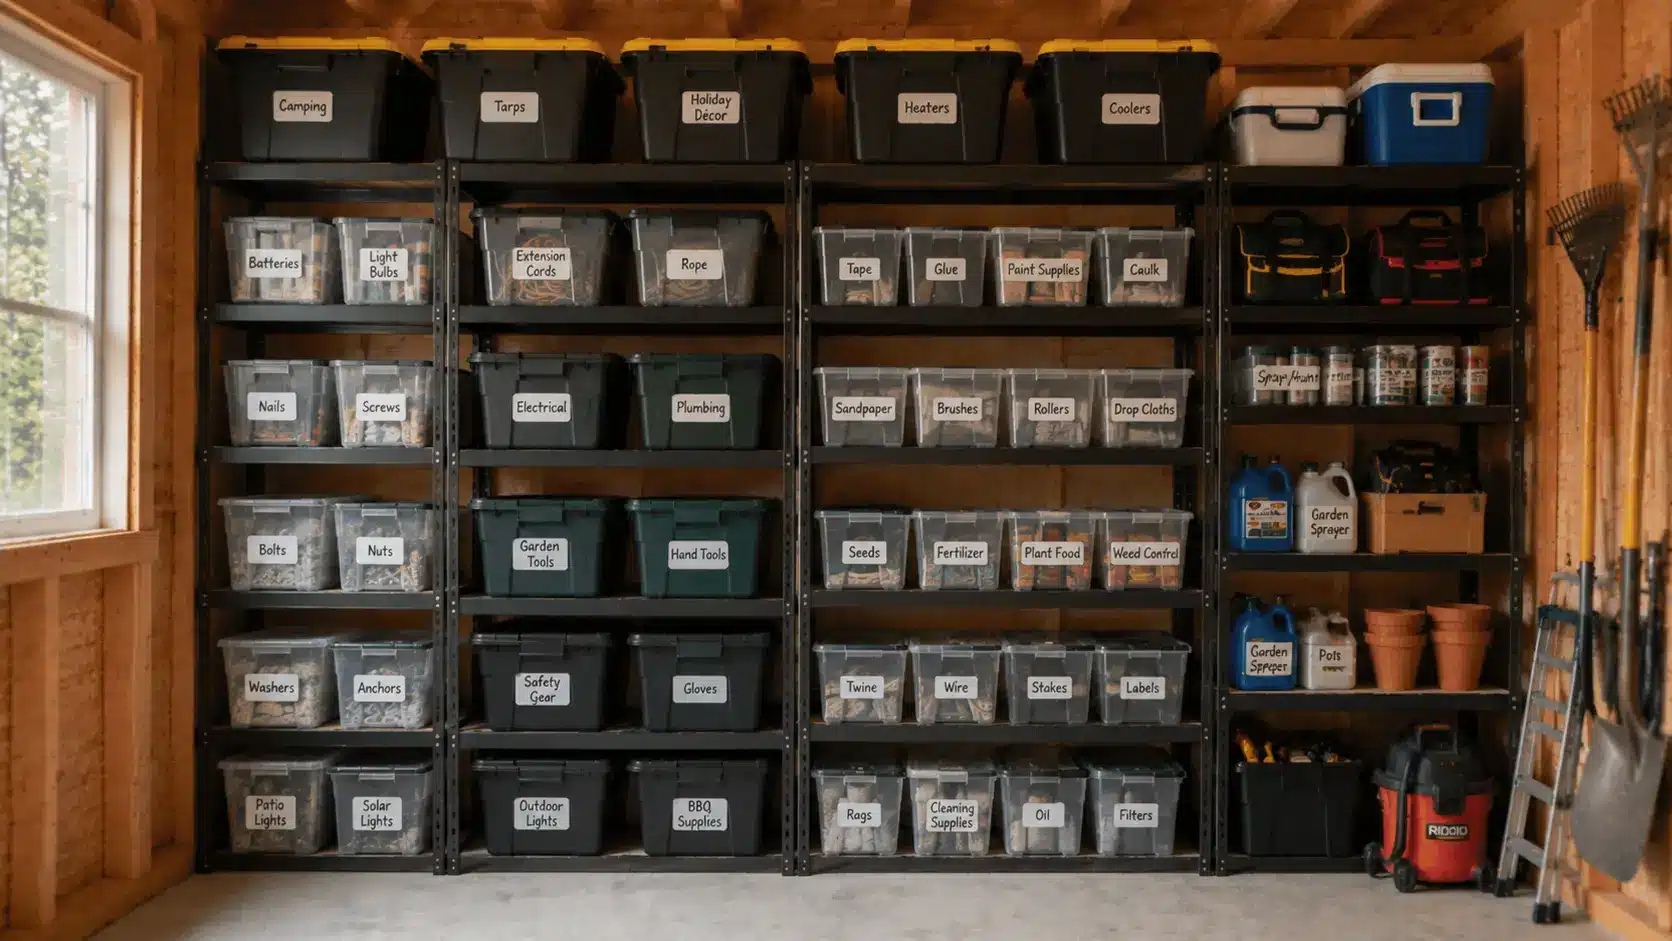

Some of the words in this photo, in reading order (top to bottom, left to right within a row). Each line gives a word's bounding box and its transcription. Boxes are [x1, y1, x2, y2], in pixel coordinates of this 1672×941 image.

[279, 99, 326, 116] Camping
[495, 100, 525, 115] Tarps
[691, 94, 731, 108] Holiday
[695, 108, 727, 120] Décor
[905, 102, 950, 114] Heaters
[1110, 102, 1150, 114] Coolers
[370, 251, 398, 265] Light
[517, 250, 565, 261] Extension
[249, 257, 299, 269] Batteries
[682, 258, 707, 273] Rope
[935, 262, 958, 275] Glue
[1130, 263, 1160, 276] Caulk
[370, 266, 398, 278] Bulbs
[527, 265, 557, 278] Cords
[847, 263, 871, 277] Tape
[1008, 263, 1035, 275] Paint
[1038, 263, 1080, 279] Supplies
[258, 400, 286, 412] Nails
[362, 401, 400, 413] Screws
[517, 401, 567, 413] Electrical
[677, 401, 725, 418] Plumbing
[835, 402, 893, 418] Sandpaper
[937, 402, 978, 414] Brushes
[1034, 402, 1070, 415] Rollers
[1114, 403, 1139, 418] Drop
[1142, 403, 1175, 415] Cloths
[1311, 508, 1349, 520] Garden
[1311, 523, 1350, 539] Sprayer
[259, 543, 286, 556] Bolts
[368, 545, 393, 557] Nuts
[520, 541, 559, 551] Garden
[849, 546, 880, 558] Seeds
[937, 546, 984, 559] Fertilizer
[672, 548, 697, 559] Hand
[700, 548, 725, 560] Tools
[1025, 547, 1052, 559] Plant
[1055, 547, 1081, 559] Food
[1113, 547, 1141, 559] Weed
[528, 556, 554, 567] Tools
[1251, 645, 1288, 658] Garden
[249, 681, 294, 694] Washers
[358, 681, 402, 694] Anchors
[525, 676, 560, 690] Safety
[684, 682, 717, 694] Gloves
[846, 680, 877, 693] Twine
[945, 681, 968, 693] Wire
[1032, 681, 1067, 693] Stakes
[1127, 682, 1159, 693] Labels
[530, 691, 556, 704] Gear
[256, 799, 284, 810] Patio
[363, 800, 391, 811] Solar
[520, 801, 564, 812] Outdoor
[689, 801, 711, 813] BBQ
[931, 801, 975, 816] Cleaning
[255, 814, 286, 828] Lights
[847, 808, 872, 823] Rags
[1035, 809, 1050, 821] Oil
[1119, 808, 1153, 821] Filters
[361, 815, 393, 829] Lights
[527, 815, 557, 828] Lights
[678, 815, 721, 829] Supplies
[931, 816, 973, 831] Supplies
